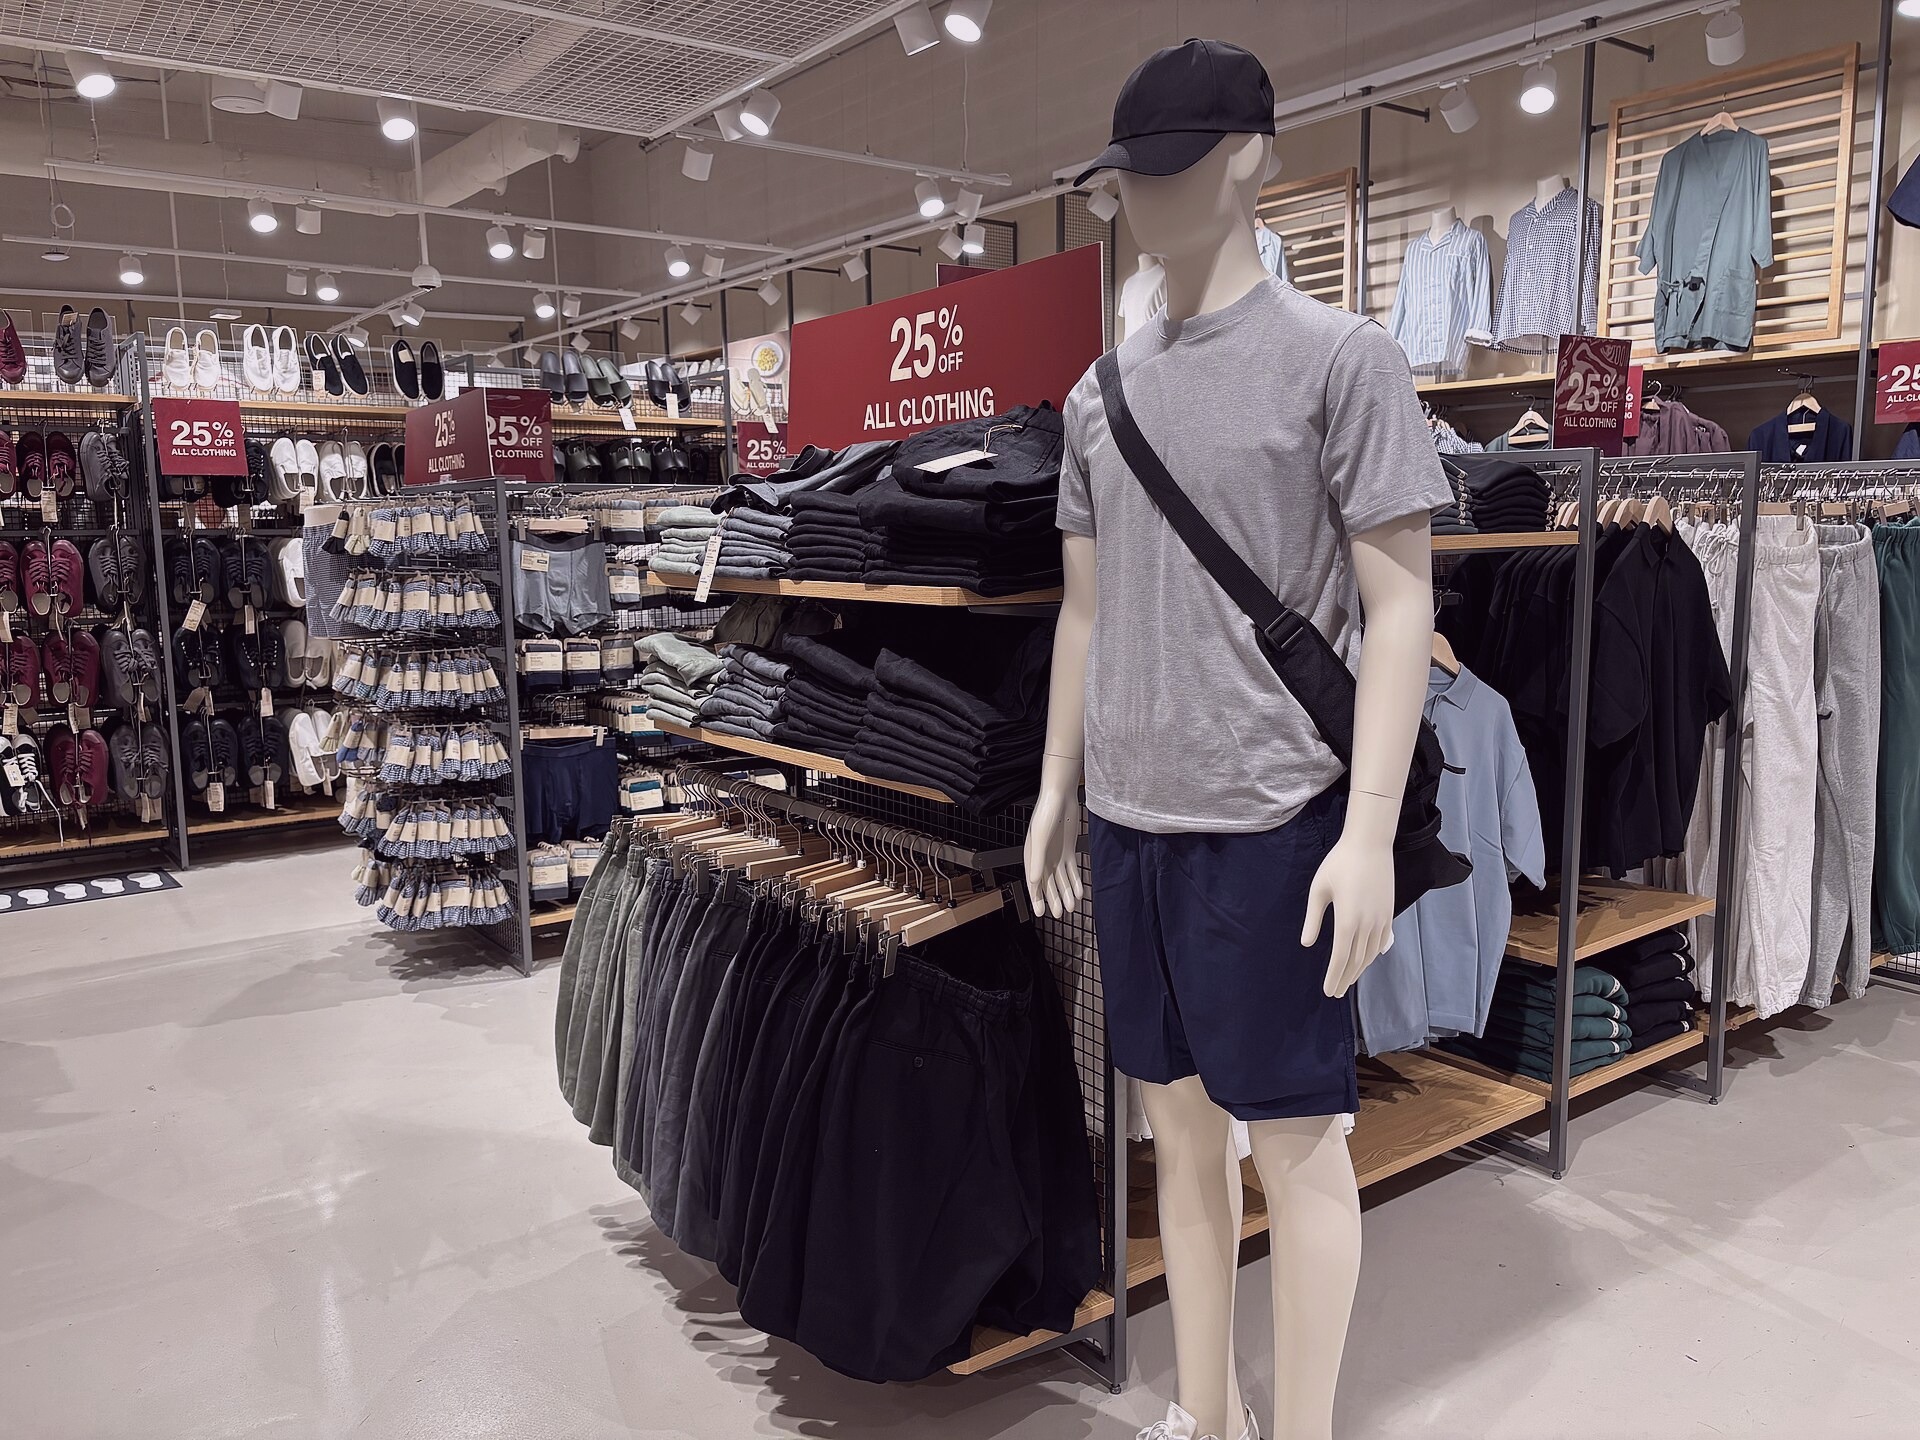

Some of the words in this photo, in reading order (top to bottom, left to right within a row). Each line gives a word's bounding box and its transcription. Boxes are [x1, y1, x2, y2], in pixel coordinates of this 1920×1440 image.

[889, 304, 964, 382] 25%
[938, 351, 964, 373] OFF
[1566, 372, 1619, 413] 25%
[1601, 402, 1618, 412] OFF
[1887, 394, 1904, 403] ALL
[1905, 393, 1920, 402] CL
[863, 401, 896, 430] ALL
[899, 386, 995, 427] CLOTHING
[434, 409, 456, 447] 25%
[1564, 417, 1578, 427] ALL
[1580, 417, 1617, 428] CLOTHING
[170, 420, 234, 447] 25%
[521, 437, 543, 447] OFF
[171, 448, 190, 456] ALL
[495, 449, 544, 458] CLOTHING
[746, 439, 786, 460] 25%
[428, 457, 439, 473] ALL
[438, 452, 465, 472] CLOTHING
